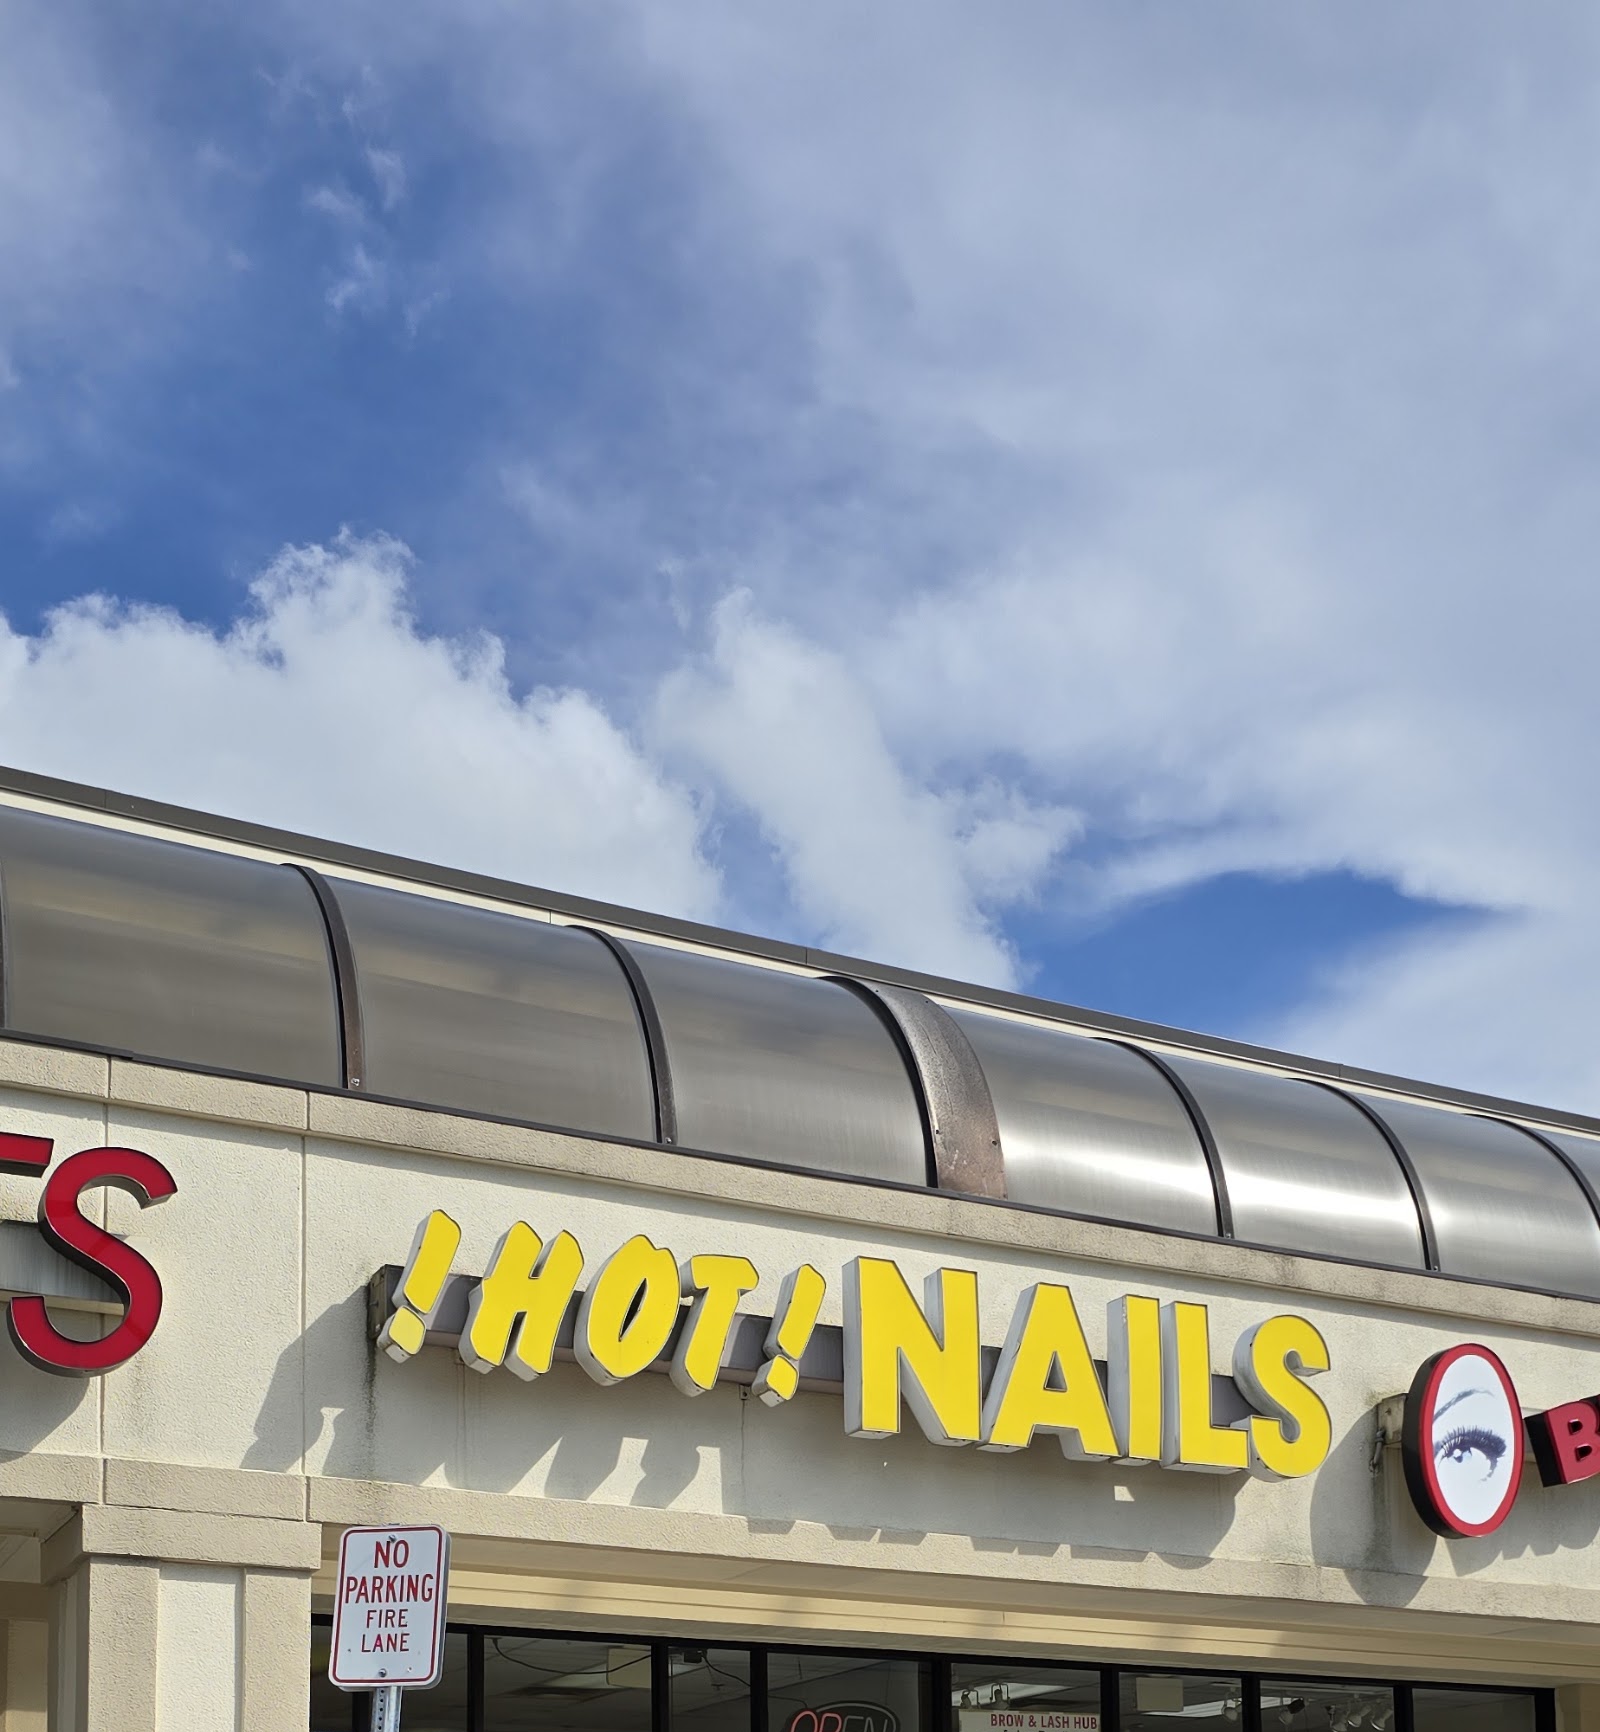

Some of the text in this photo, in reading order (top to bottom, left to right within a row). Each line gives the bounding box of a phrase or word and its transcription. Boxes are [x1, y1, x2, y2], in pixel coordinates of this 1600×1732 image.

[0, 1132, 178, 1374] S
[846, 1256, 1331, 1480] NAILS
[374, 1539, 409, 1568] NO
[345, 1574, 434, 1604] PARKING
[366, 1609, 409, 1629] FIRE
[361, 1633, 410, 1653] LANE
[990, 1713, 1098, 1730] BROW & LASH HUB
